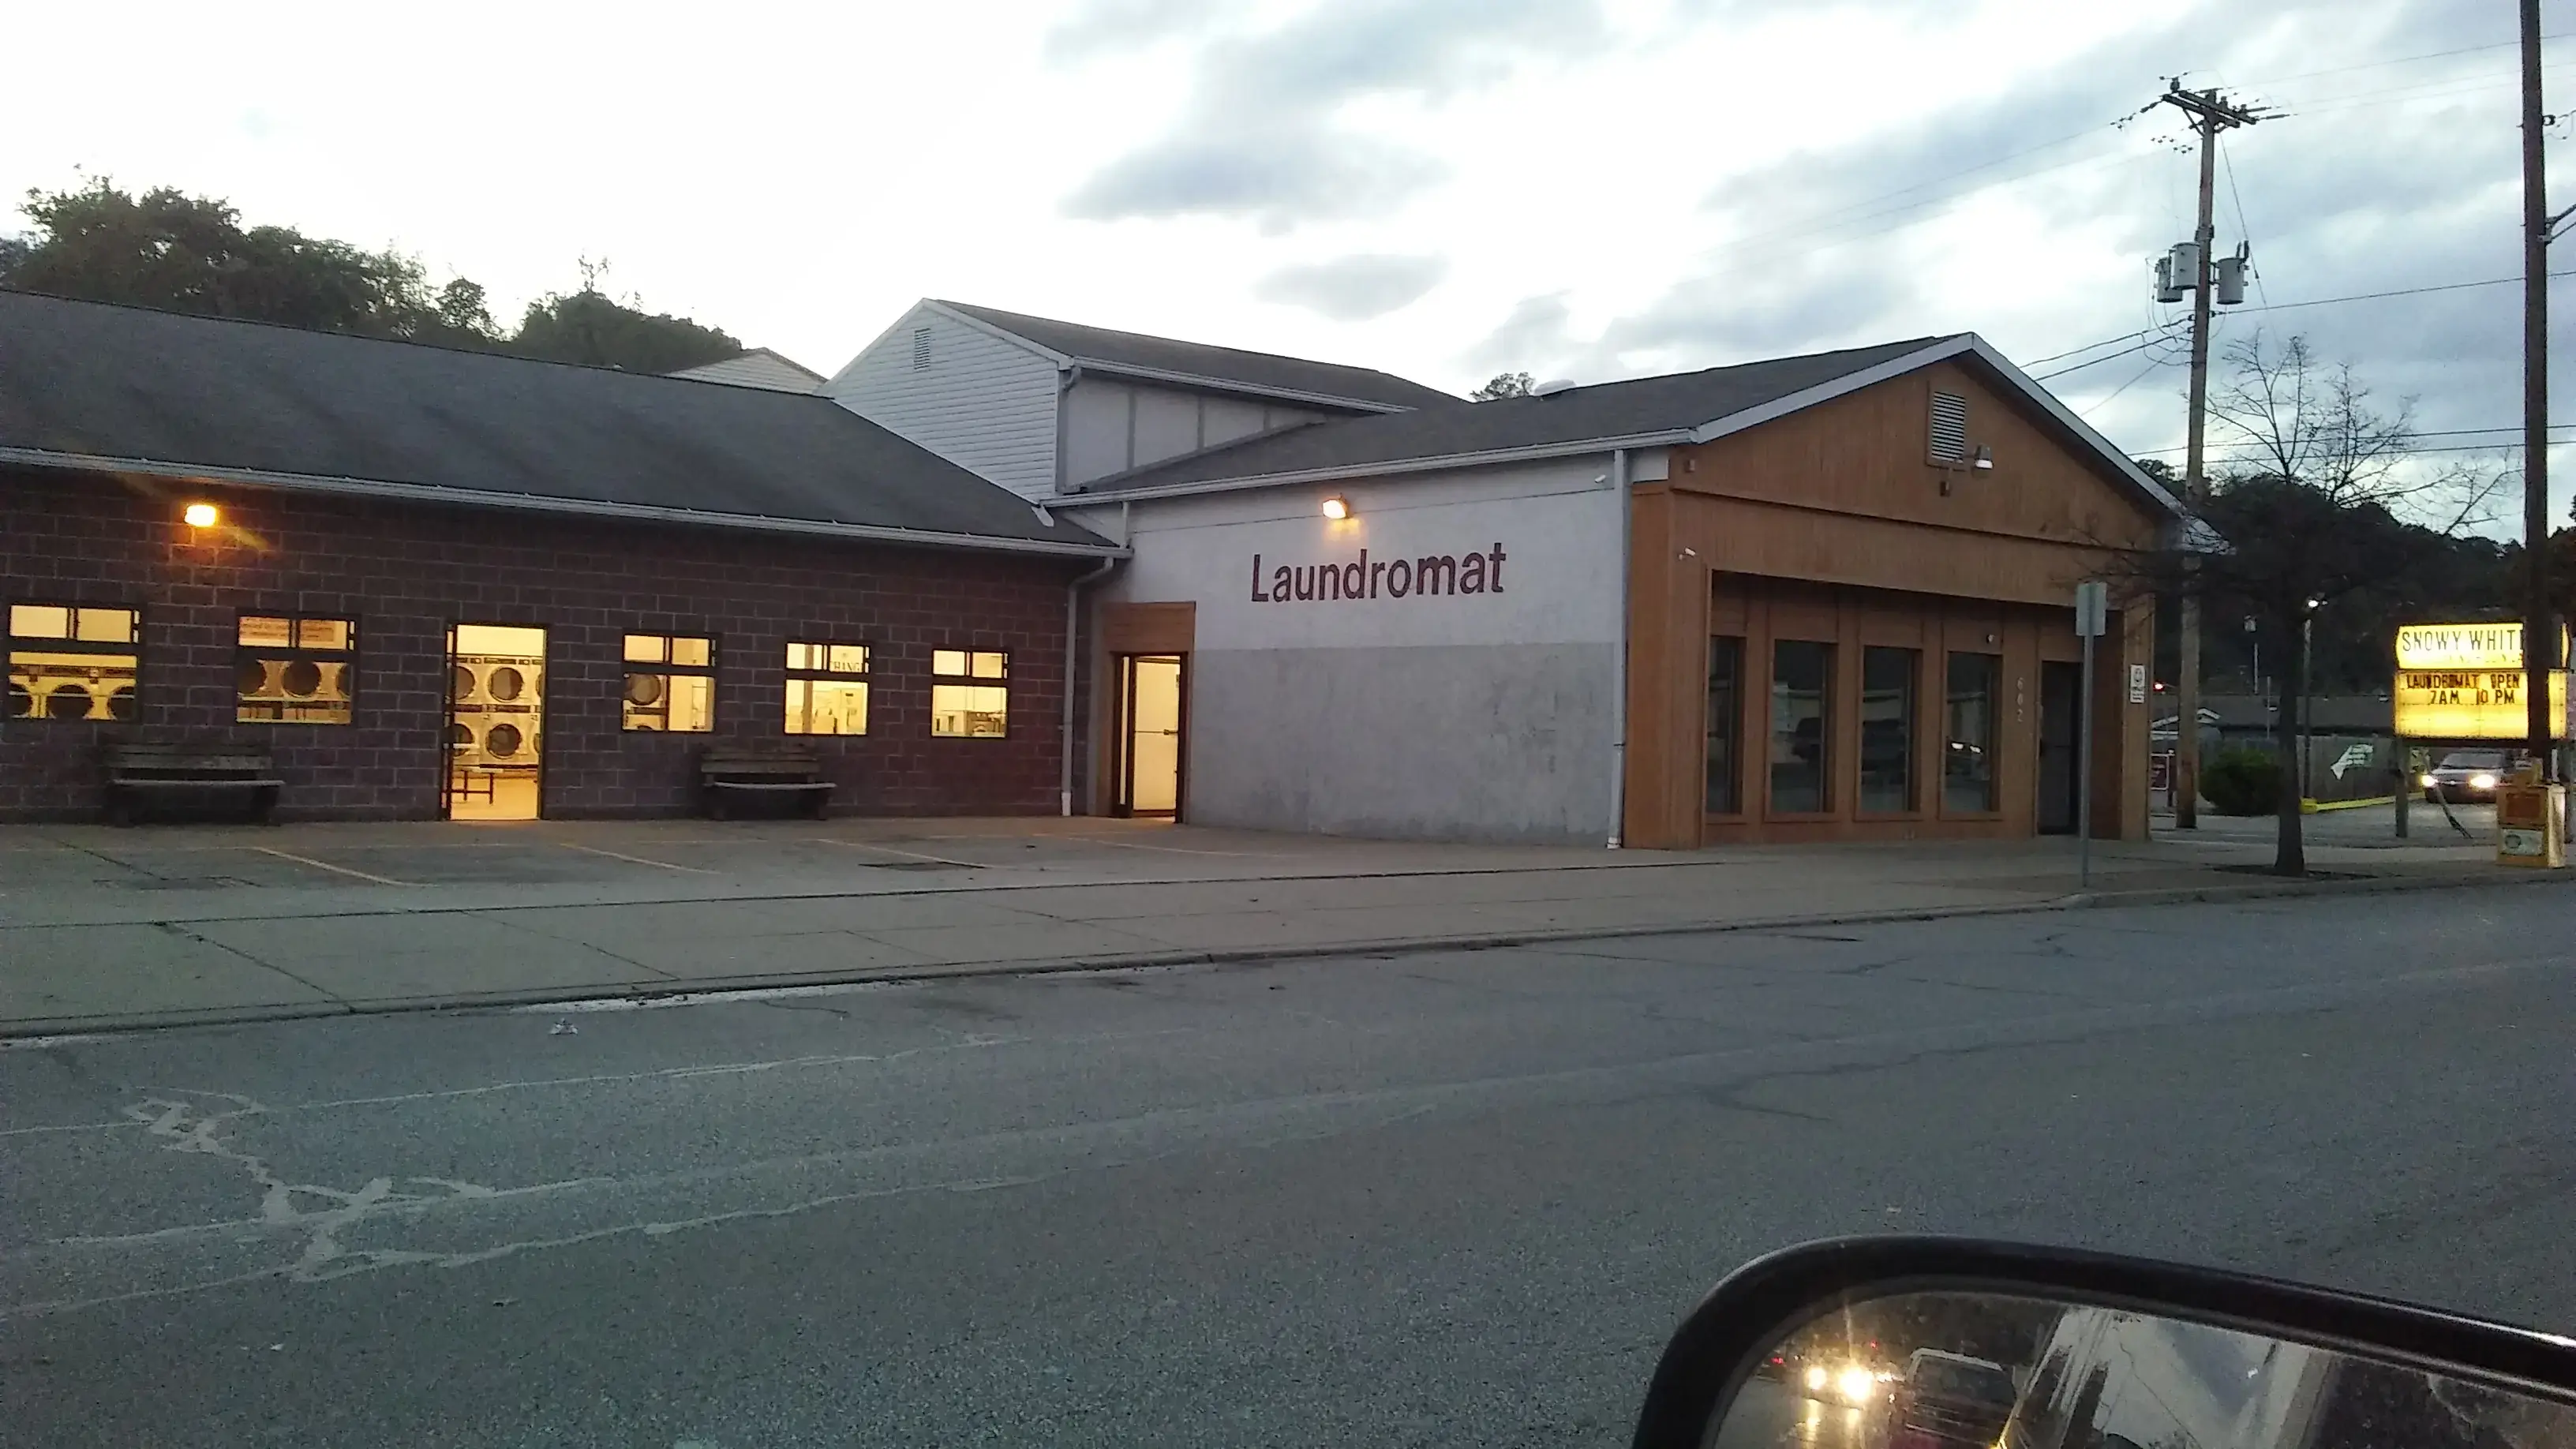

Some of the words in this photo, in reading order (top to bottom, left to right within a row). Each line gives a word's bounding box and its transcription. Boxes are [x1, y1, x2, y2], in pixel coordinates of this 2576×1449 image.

[1252, 542, 1507, 603] Laundromat
[2402, 631, 2462, 652] SNOWY
[2490, 673, 2520, 689] OPEN
[2476, 689, 2488, 706] 10
[2495, 689, 2515, 705] PM
